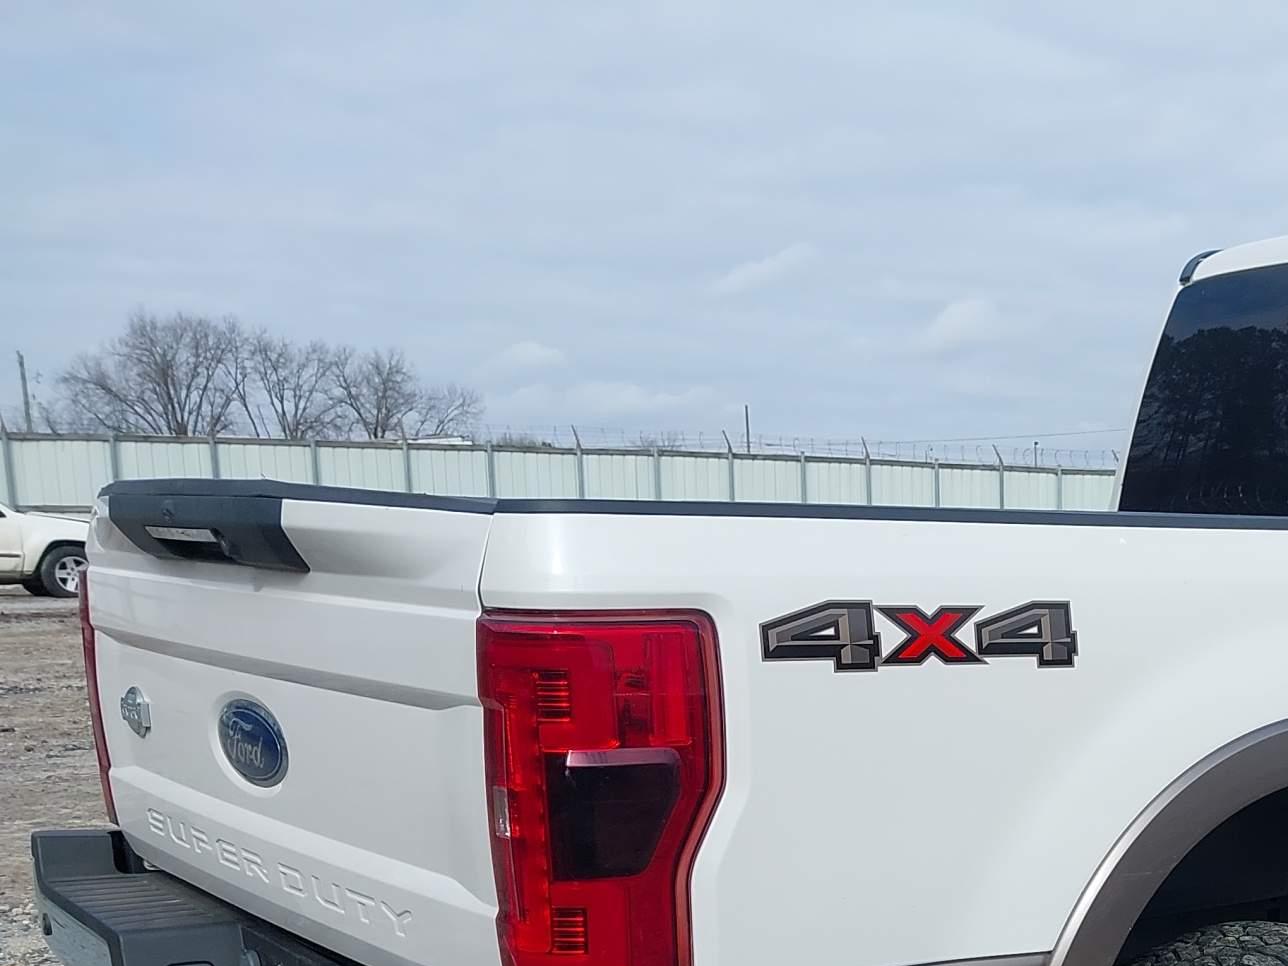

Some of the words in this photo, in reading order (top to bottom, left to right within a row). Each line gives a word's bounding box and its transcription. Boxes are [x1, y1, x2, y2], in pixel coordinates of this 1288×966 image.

[759, 599, 1078, 673] 4X4
[226, 717, 265, 769] Ford
[145, 807, 270, 884] SUPER
[277, 862, 414, 938] DUTY
